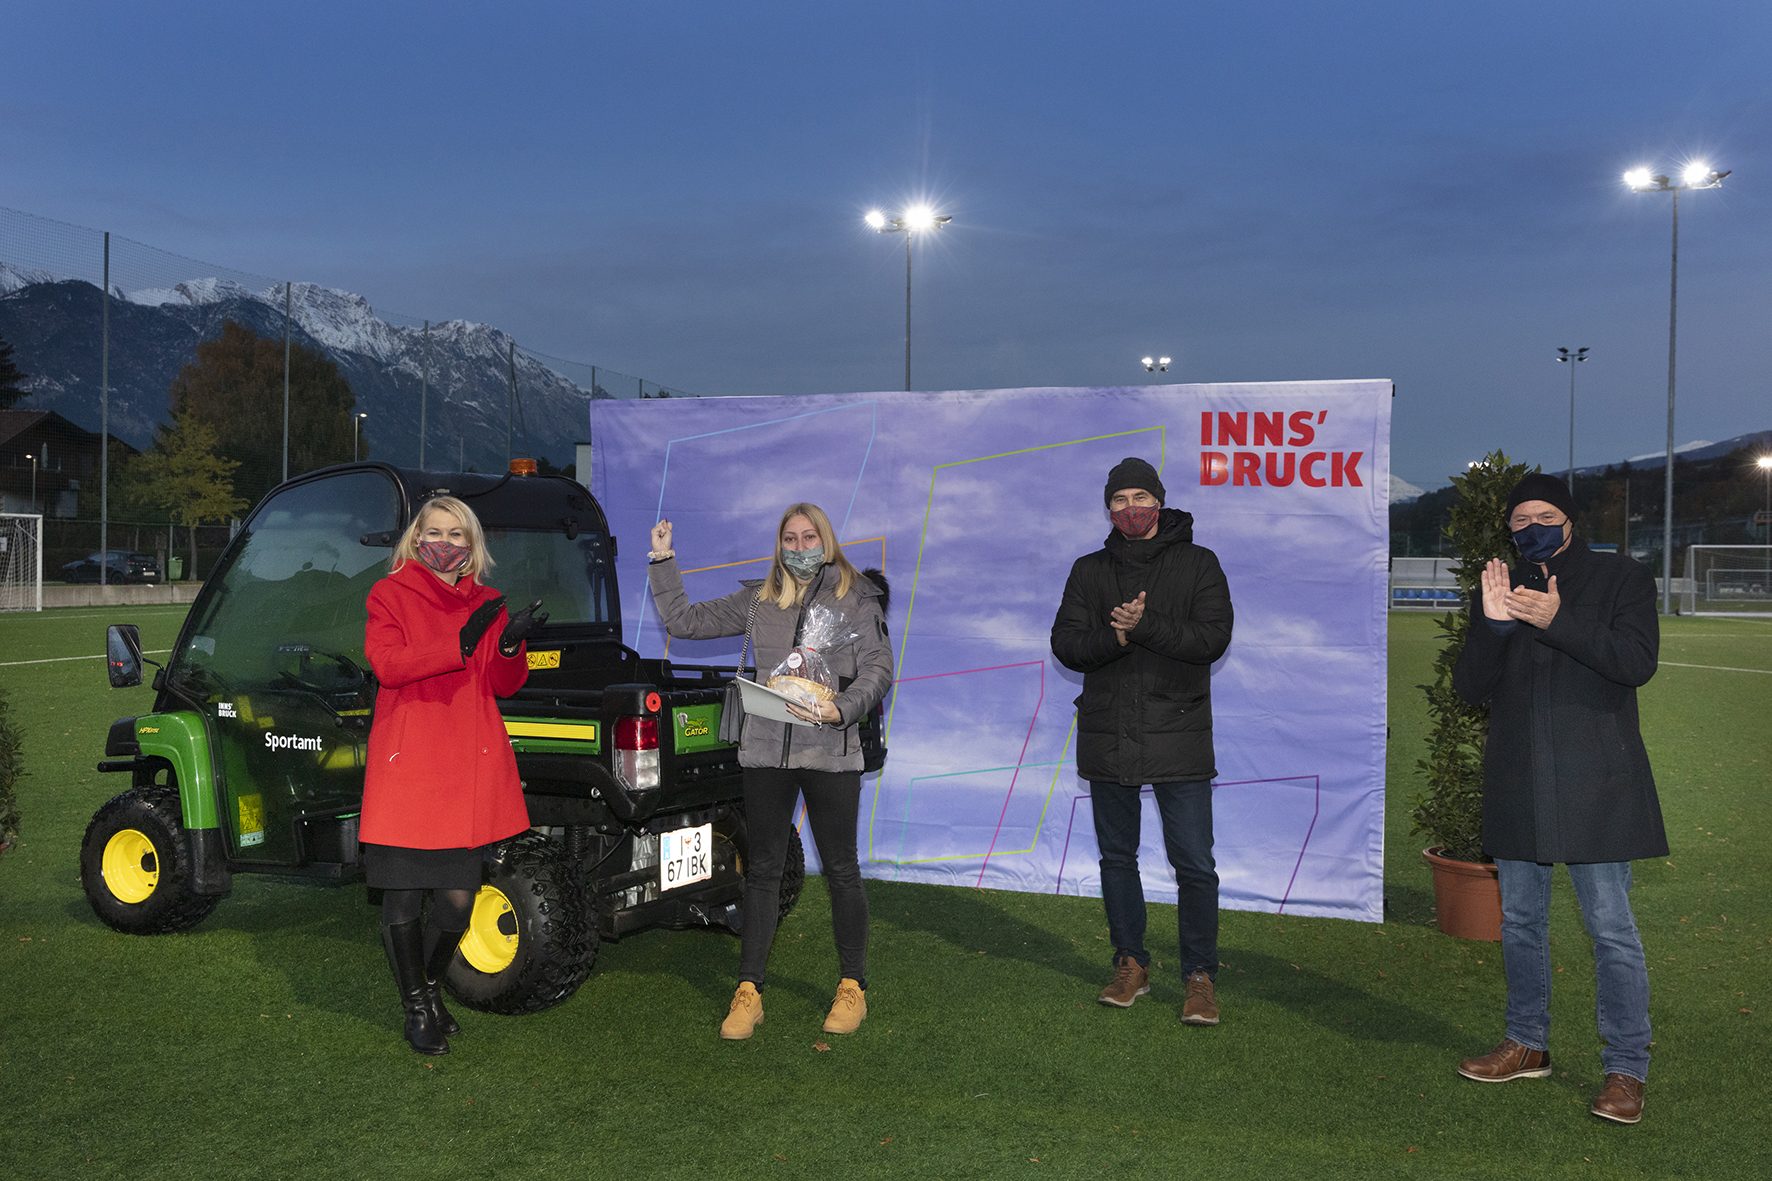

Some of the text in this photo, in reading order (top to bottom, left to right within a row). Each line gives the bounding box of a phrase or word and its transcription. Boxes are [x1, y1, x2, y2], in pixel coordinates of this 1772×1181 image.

[1200, 410, 1328, 447] INNS'
[1200, 451, 1364, 488] BRUCK
[218, 709, 237, 718] BRUCK
[265, 731, 323, 752] Sportamt
[684, 727, 708, 737] GATOR
[694, 831, 701, 852] 3
[667, 852, 707, 883] 67 IBK
